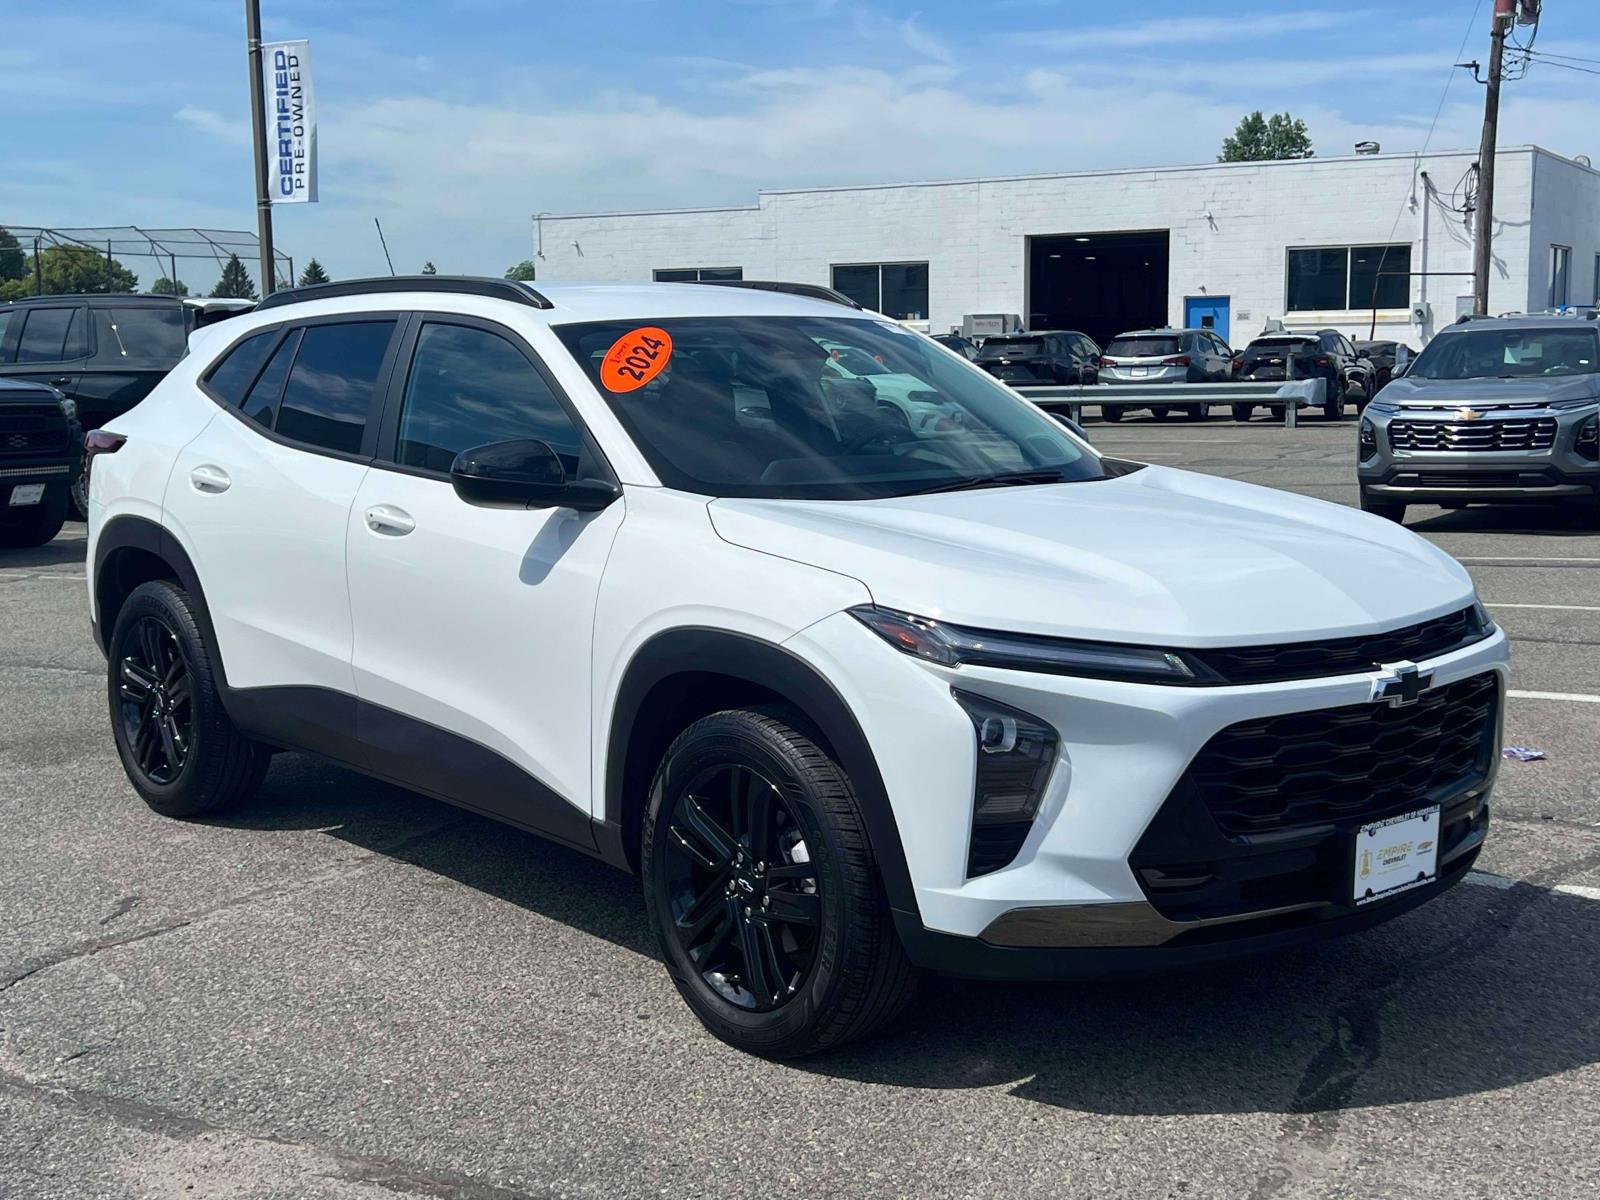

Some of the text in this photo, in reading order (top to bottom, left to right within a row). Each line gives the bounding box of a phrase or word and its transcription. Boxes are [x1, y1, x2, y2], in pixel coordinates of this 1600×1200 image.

[274, 50, 294, 195] CERTIFIED
[288, 55, 305, 189] PRE-OWNED
[617, 335, 666, 381] 2024
[1376, 841, 1414, 860] EMPIRE
